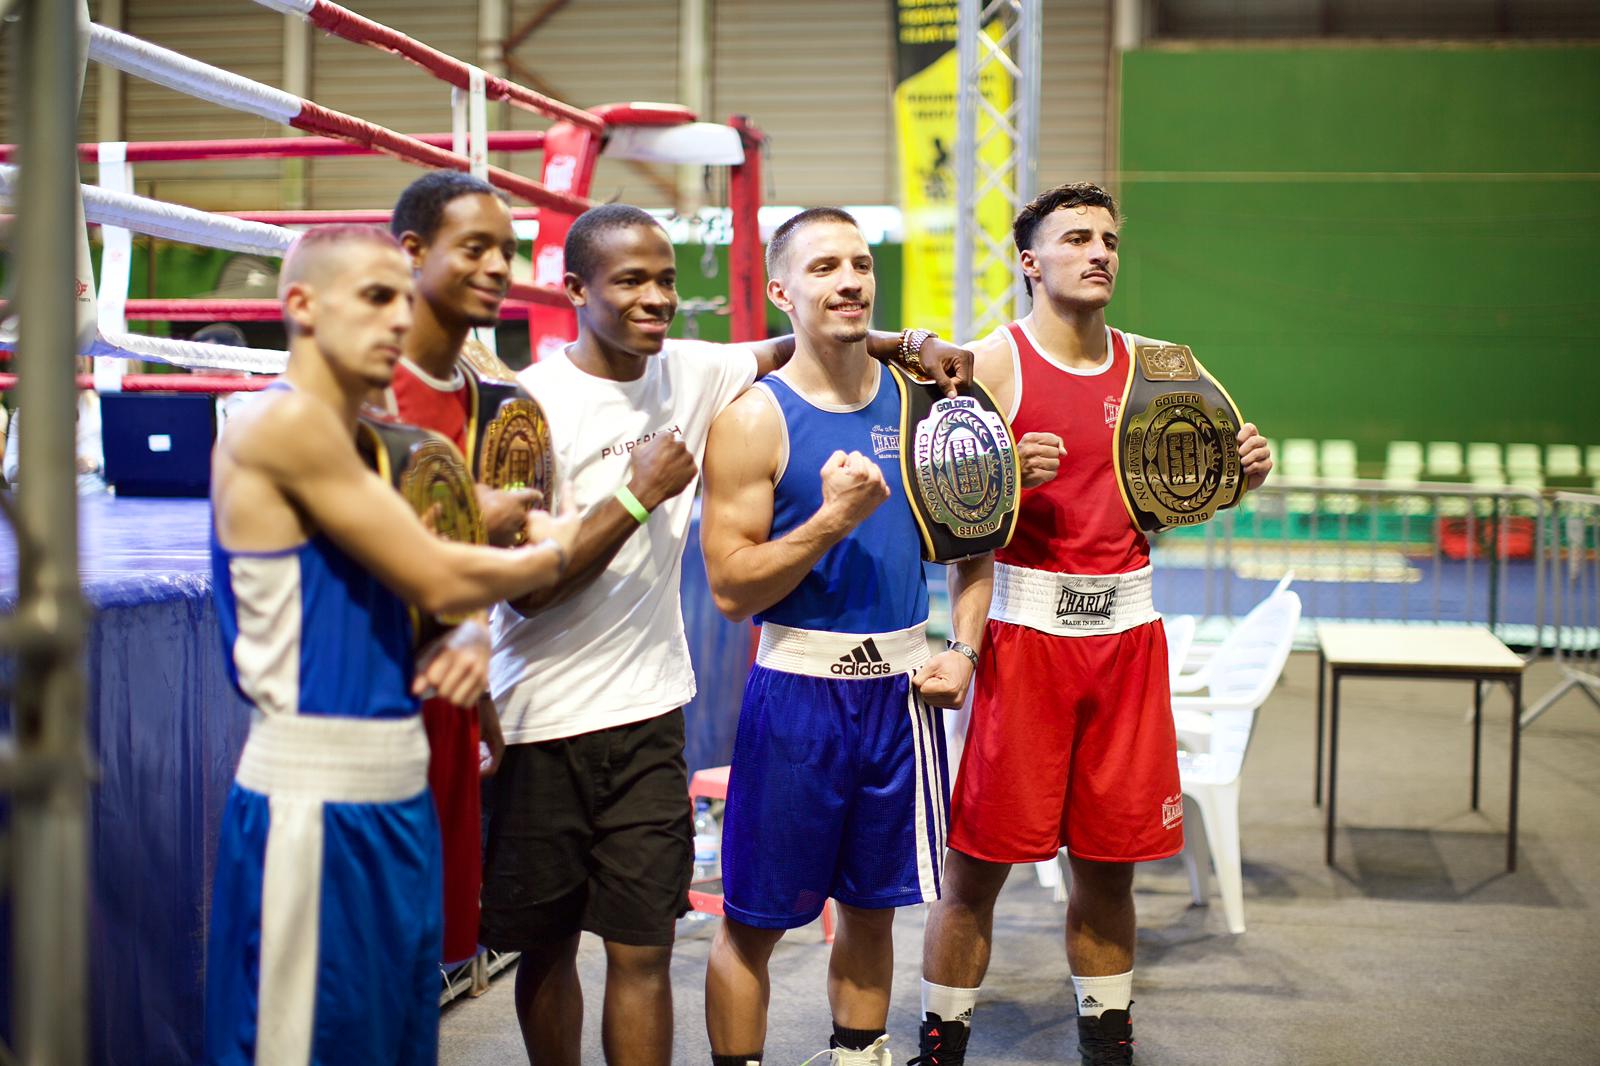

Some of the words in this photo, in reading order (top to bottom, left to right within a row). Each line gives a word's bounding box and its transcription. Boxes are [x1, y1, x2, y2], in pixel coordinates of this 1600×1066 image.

[936, 400, 975, 412] GOLDEN
[1154, 395, 1200, 407] GOLDEN
[993, 424, 1015, 497] F2CAR.COM
[1129, 426, 1149, 501] CHAMPION
[1219, 420, 1236, 489] F2CAR.COM
[918, 433, 942, 512] CHAMPION
[959, 521, 996, 535] GLOVES
[1166, 512, 1209, 524] GLOVES
[1056, 588, 1117, 616] CHARLIE
[830, 661, 891, 676] adidas
